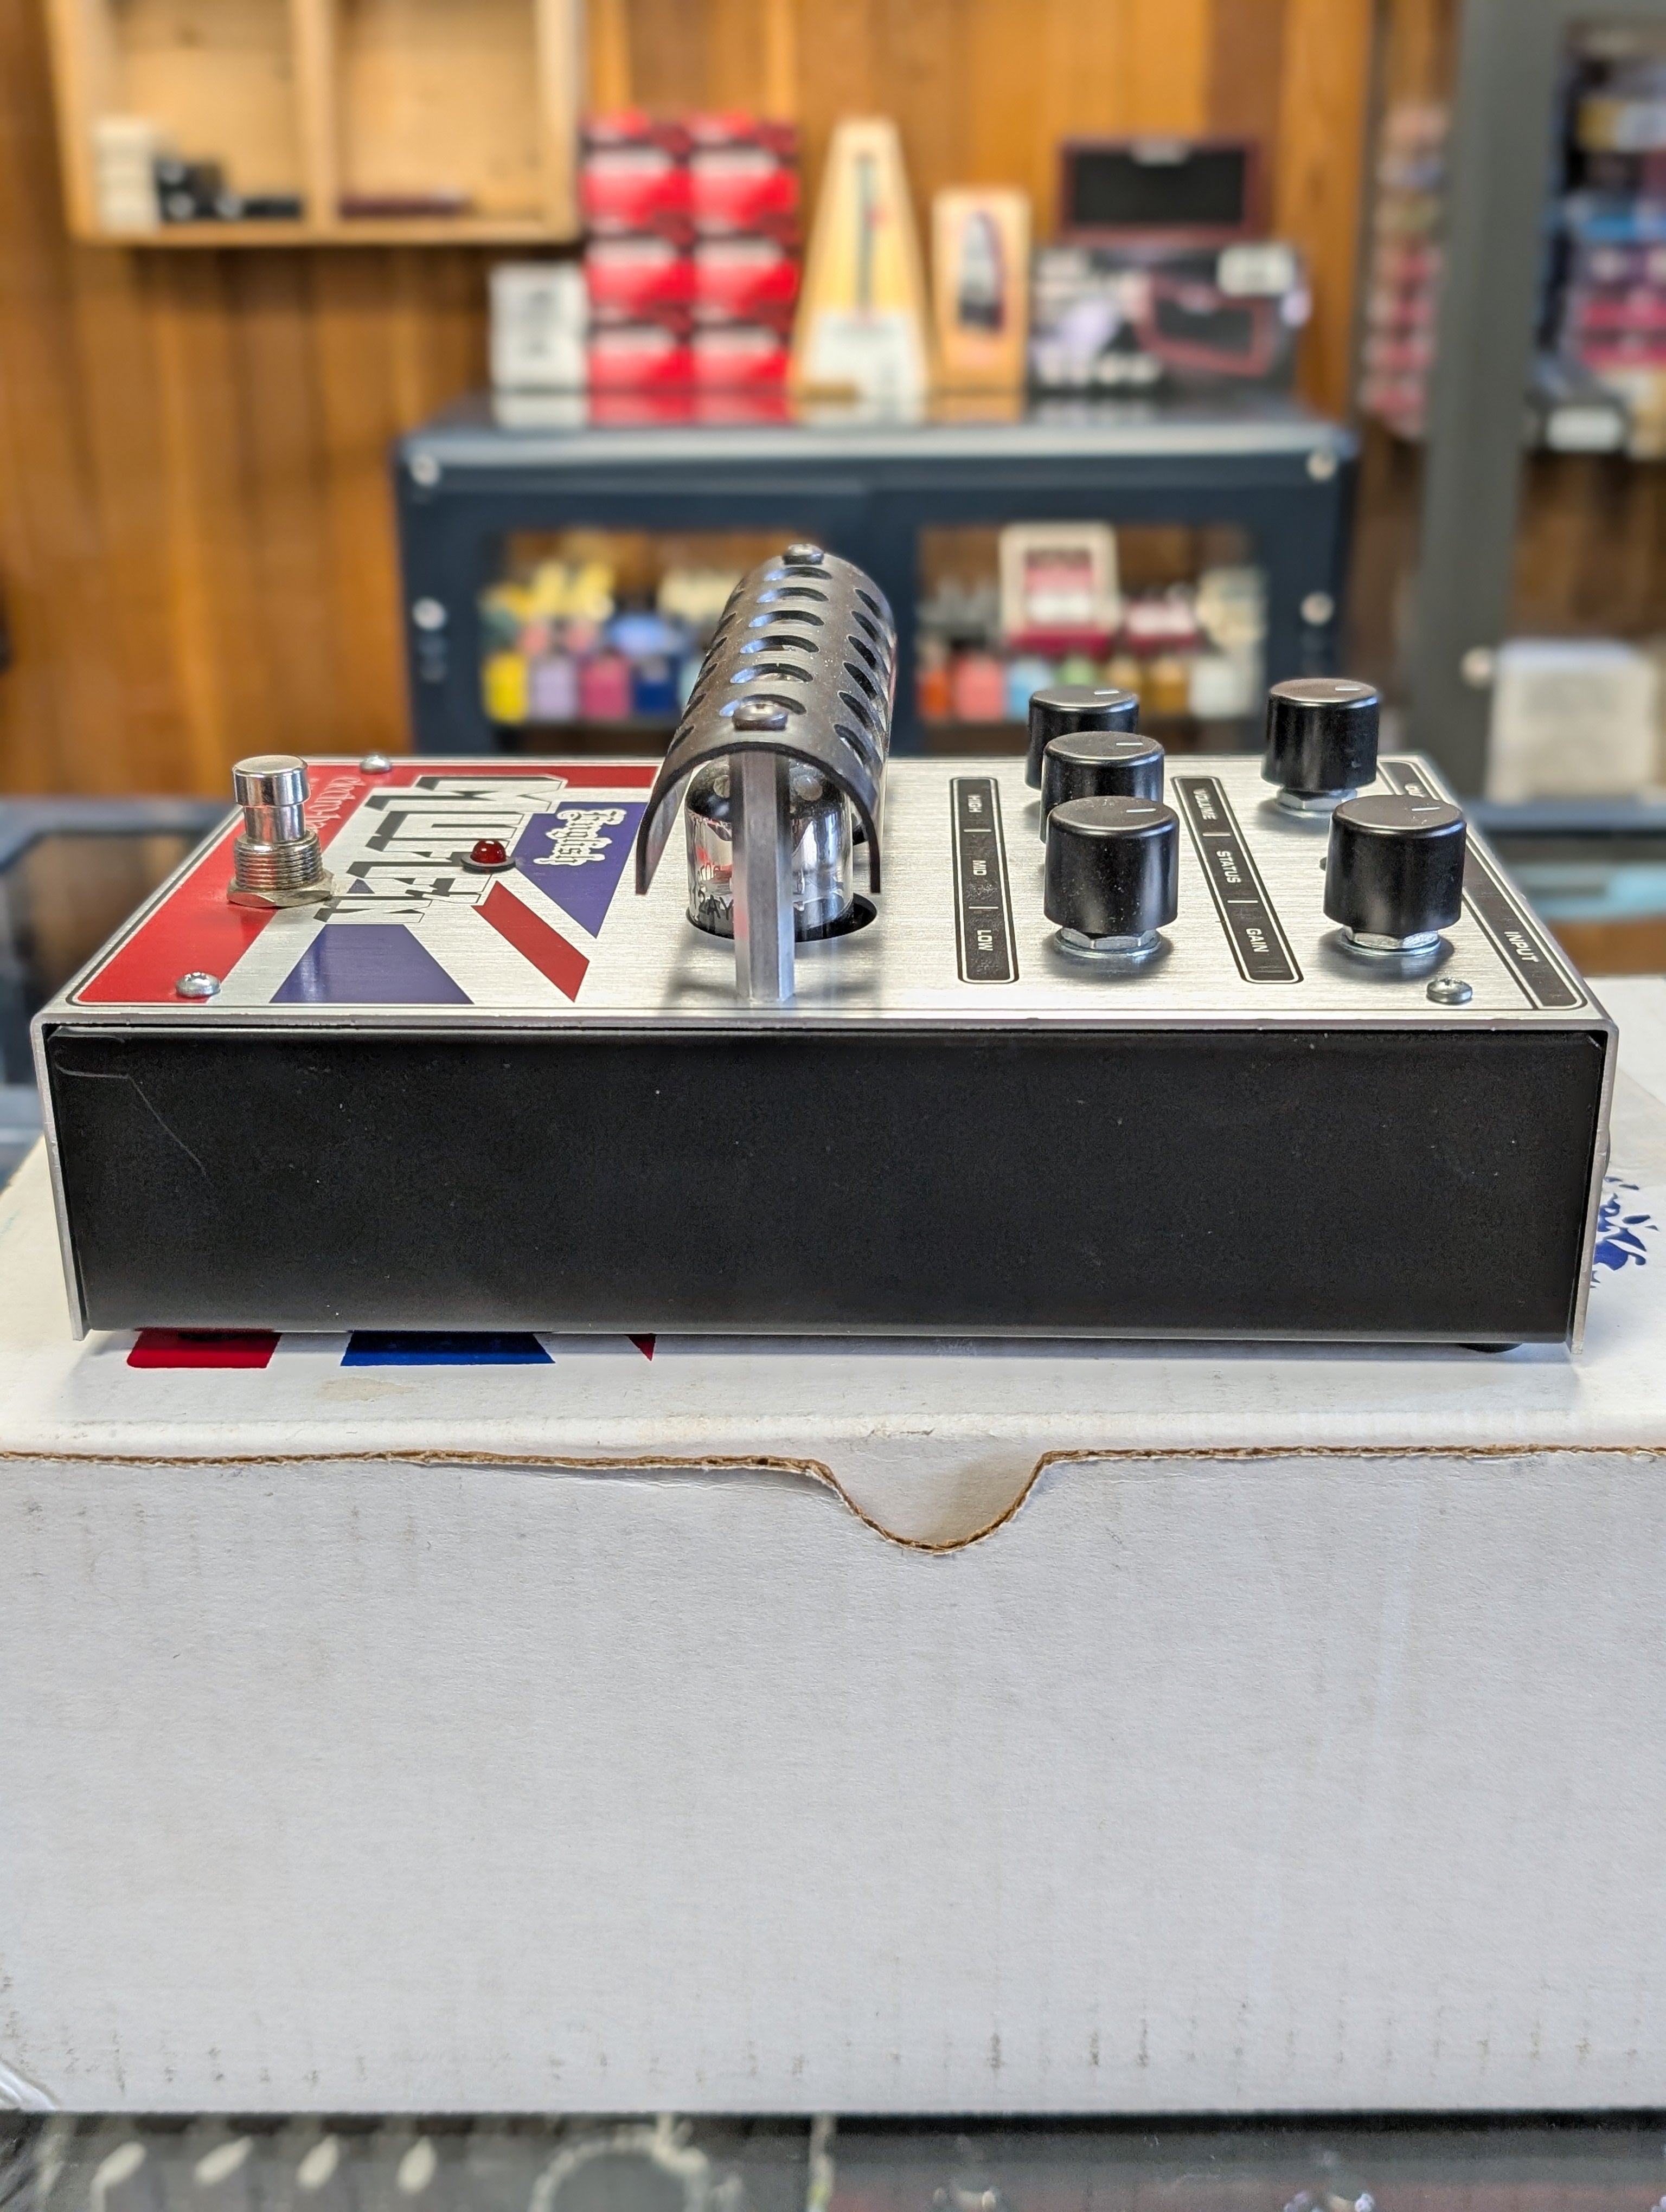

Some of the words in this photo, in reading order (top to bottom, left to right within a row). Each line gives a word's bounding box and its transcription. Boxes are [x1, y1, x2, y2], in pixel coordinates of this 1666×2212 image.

[967, 795, 982, 812] HIGH
[1194, 788, 1218, 820] VOLUME
[534, 809, 626, 865] English
[972, 860, 987, 876] MID
[1216, 851, 1241, 883] STATUS
[977, 930, 994, 951] LOW
[1246, 928, 1270, 953] GAIN
[1504, 931, 1539, 962] INPUT
